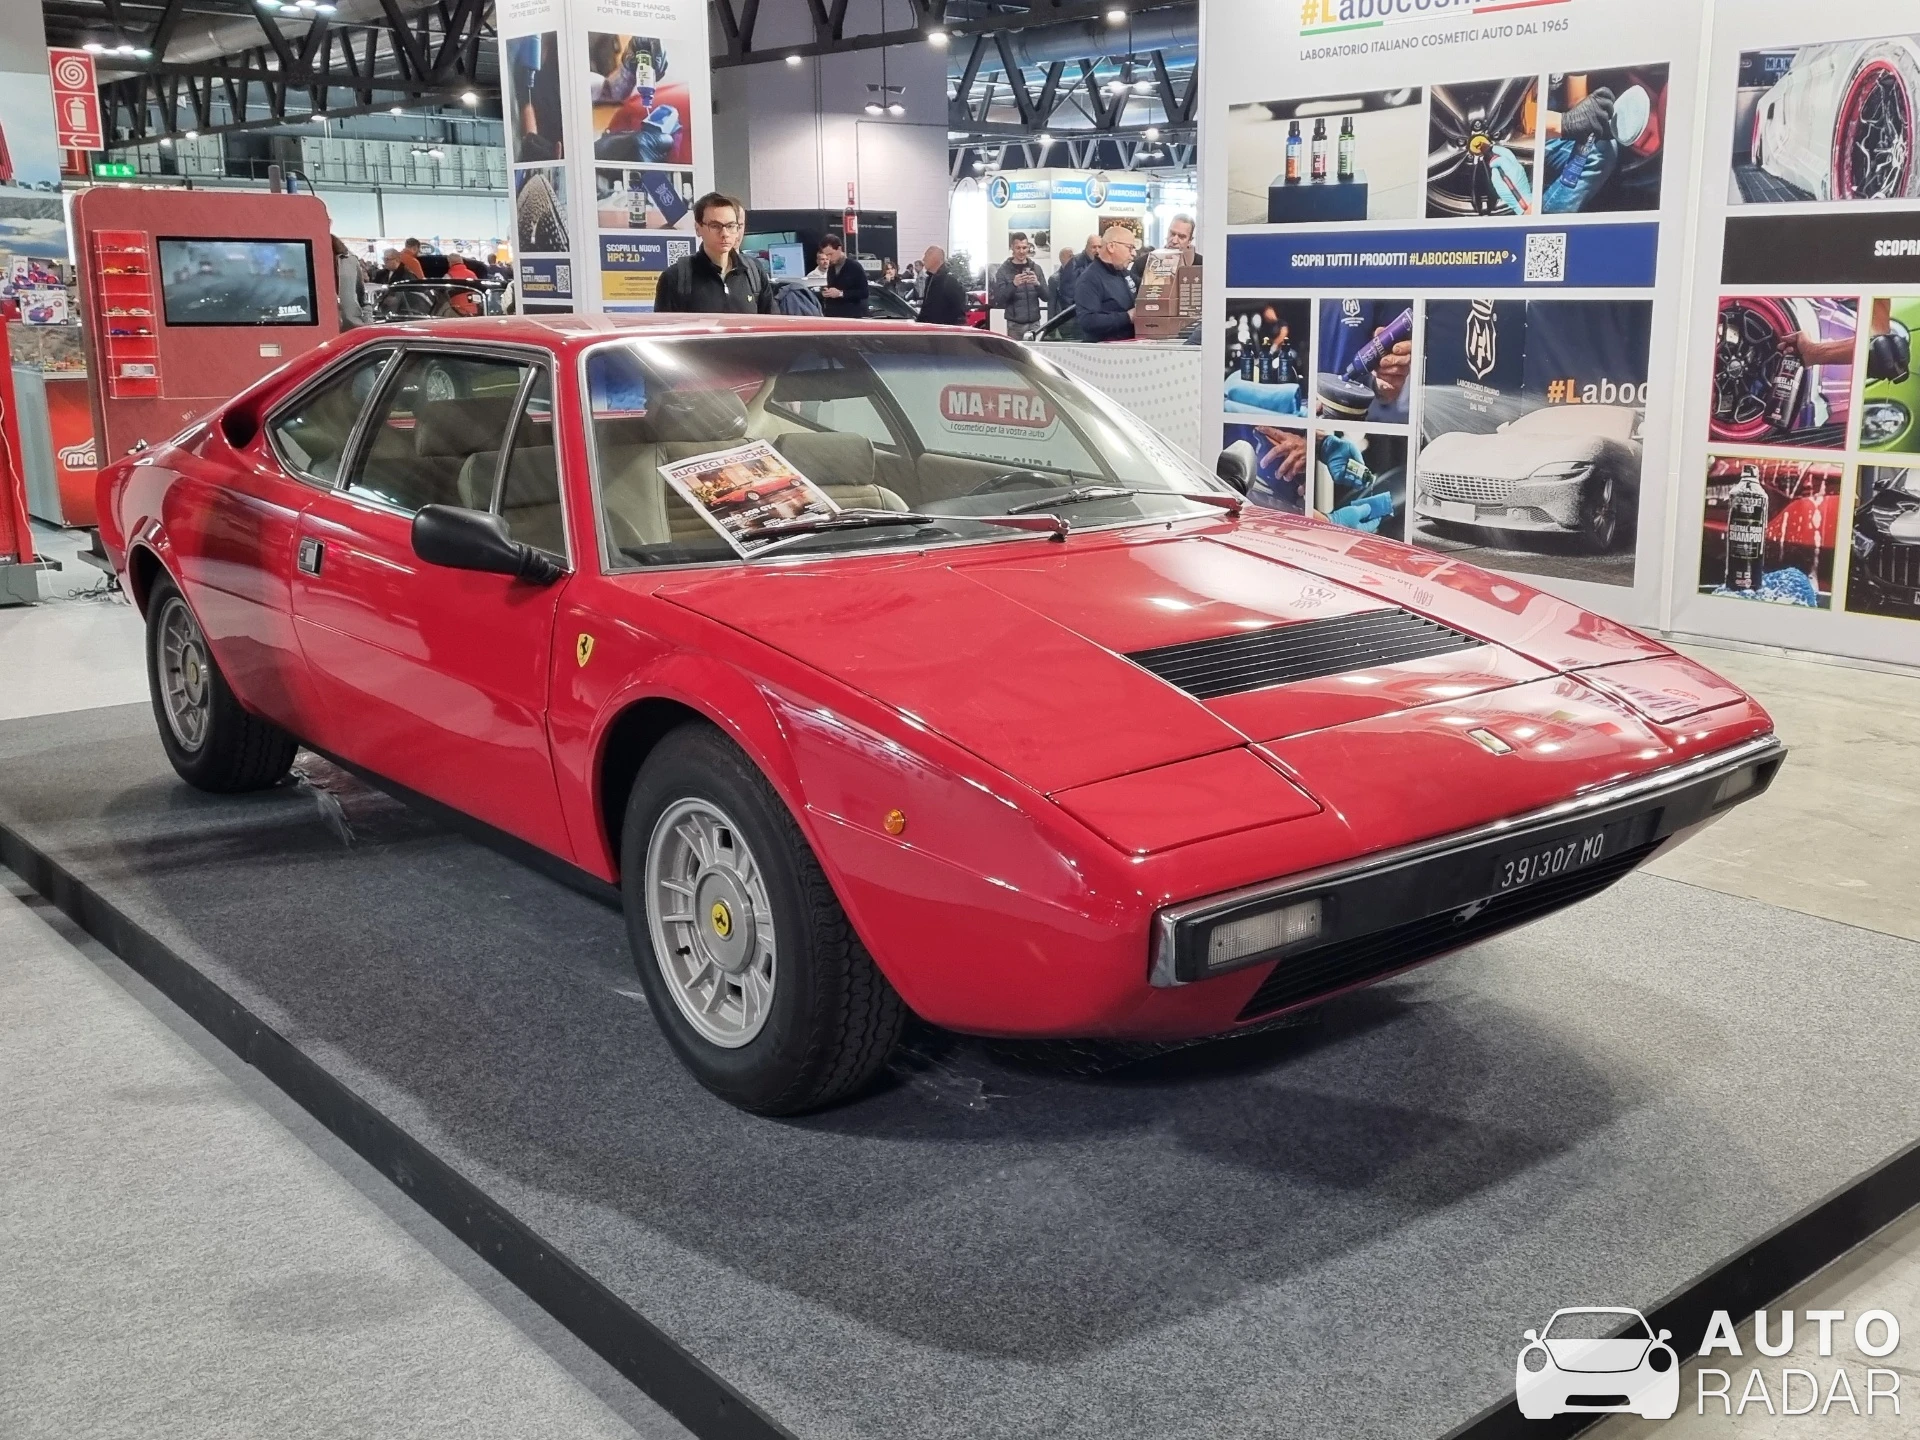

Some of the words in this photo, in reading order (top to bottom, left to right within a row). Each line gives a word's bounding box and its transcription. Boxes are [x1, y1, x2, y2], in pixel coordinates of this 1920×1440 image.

[621, 0, 641, 8] BEST
[643, 3, 671, 12] HANDS
[596, 6, 614, 14] FOR
[615, 8, 632, 16] THE
[633, 10, 653, 18] BEST
[655, 12, 677, 21] CARS
[1300, 43, 1369, 61] LABORATORIO
[1371, 37, 1419, 53] ITALIANO
[1421, 30, 1479, 47] COSMETICI
[1481, 25, 1513, 40] AUTO
[1516, 22, 1538, 36] DAL
[1541, 18, 1569, 32] 1965
[1052, 186, 1083, 195] SCUDERIA
[1108, 189, 1146, 198] AMBROSIANA
[606, 244, 630, 252] SCOPRI
[638, 244, 661, 252] NUOVO
[607, 253, 625, 263] HPC
[626, 253, 640, 263] 2.0
[1291, 254, 1325, 267] SCOPRI
[1326, 253, 1352, 267] TUTTI
[1353, 253, 1358, 266] I
[1359, 252, 1407, 266] PRODOTTI
[278, 305, 302, 314] START
[954, 423, 985, 433] cosmetici
[985, 425, 997, 436] per
[998, 426, 1005, 434] la
[1006, 427, 1027, 437] vostra
[1028, 429, 1045, 438] auto
[719, 513, 743, 525] DINO
[1729, 531, 1762, 543] SHAMPOO
[1501, 842, 1577, 888] 391307
[1580, 833, 1604, 864] MO
